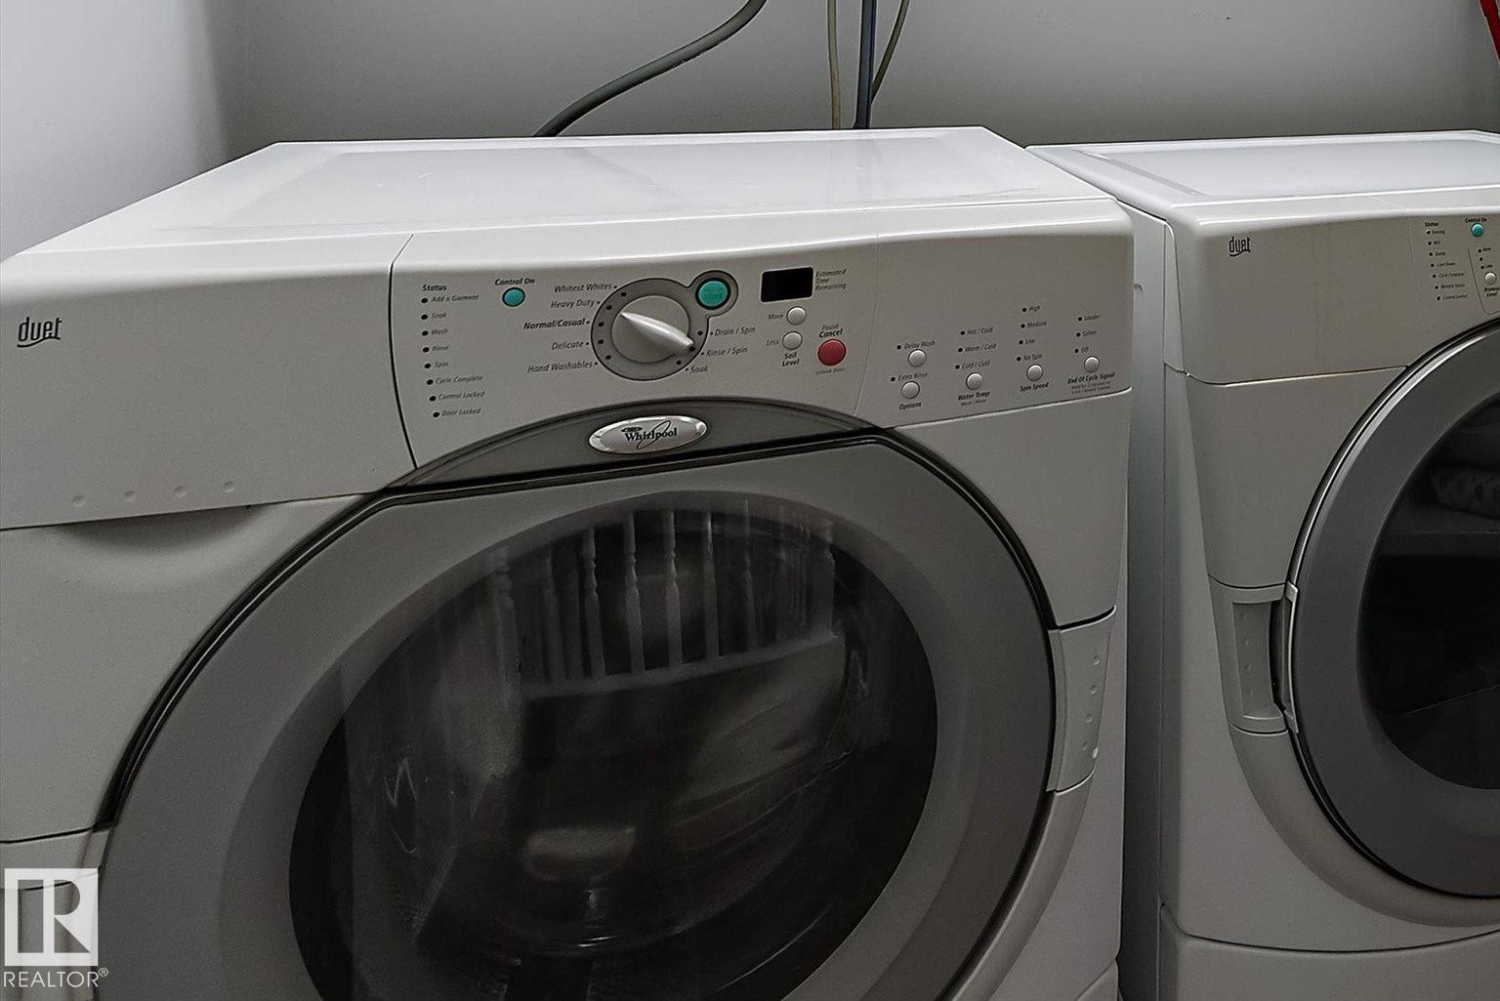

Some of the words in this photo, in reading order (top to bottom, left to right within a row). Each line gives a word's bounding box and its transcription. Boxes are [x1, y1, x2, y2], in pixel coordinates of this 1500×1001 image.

[1229, 236, 1251, 254] duet
[494, 278, 522, 286] Control
[524, 277, 535, 285] On
[422, 284, 447, 292] Status
[554, 284, 585, 293] Whitest
[586, 283, 612, 291] Whites
[551, 300, 576, 309] Heavy
[576, 299, 595, 308] Duty
[17, 316, 62, 343] duet
[715, 328, 734, 336] Drain
[740, 326, 756, 335] Spin
[819, 328, 844, 338] Cancel
[551, 341, 584, 350] Delicate
[706, 349, 726, 357] Rinse
[732, 346, 748, 356] Spin
[784, 351, 798, 359] Soil
[527, 364, 549, 373] Hand
[551, 360, 593, 371] Washables
[782, 359, 800, 367] Level
[691, 365, 708, 373] Soak
[1033, 382, 1049, 390] Speed
[899, 401, 922, 410] Options
[624, 423, 678, 446] Whirlpool
